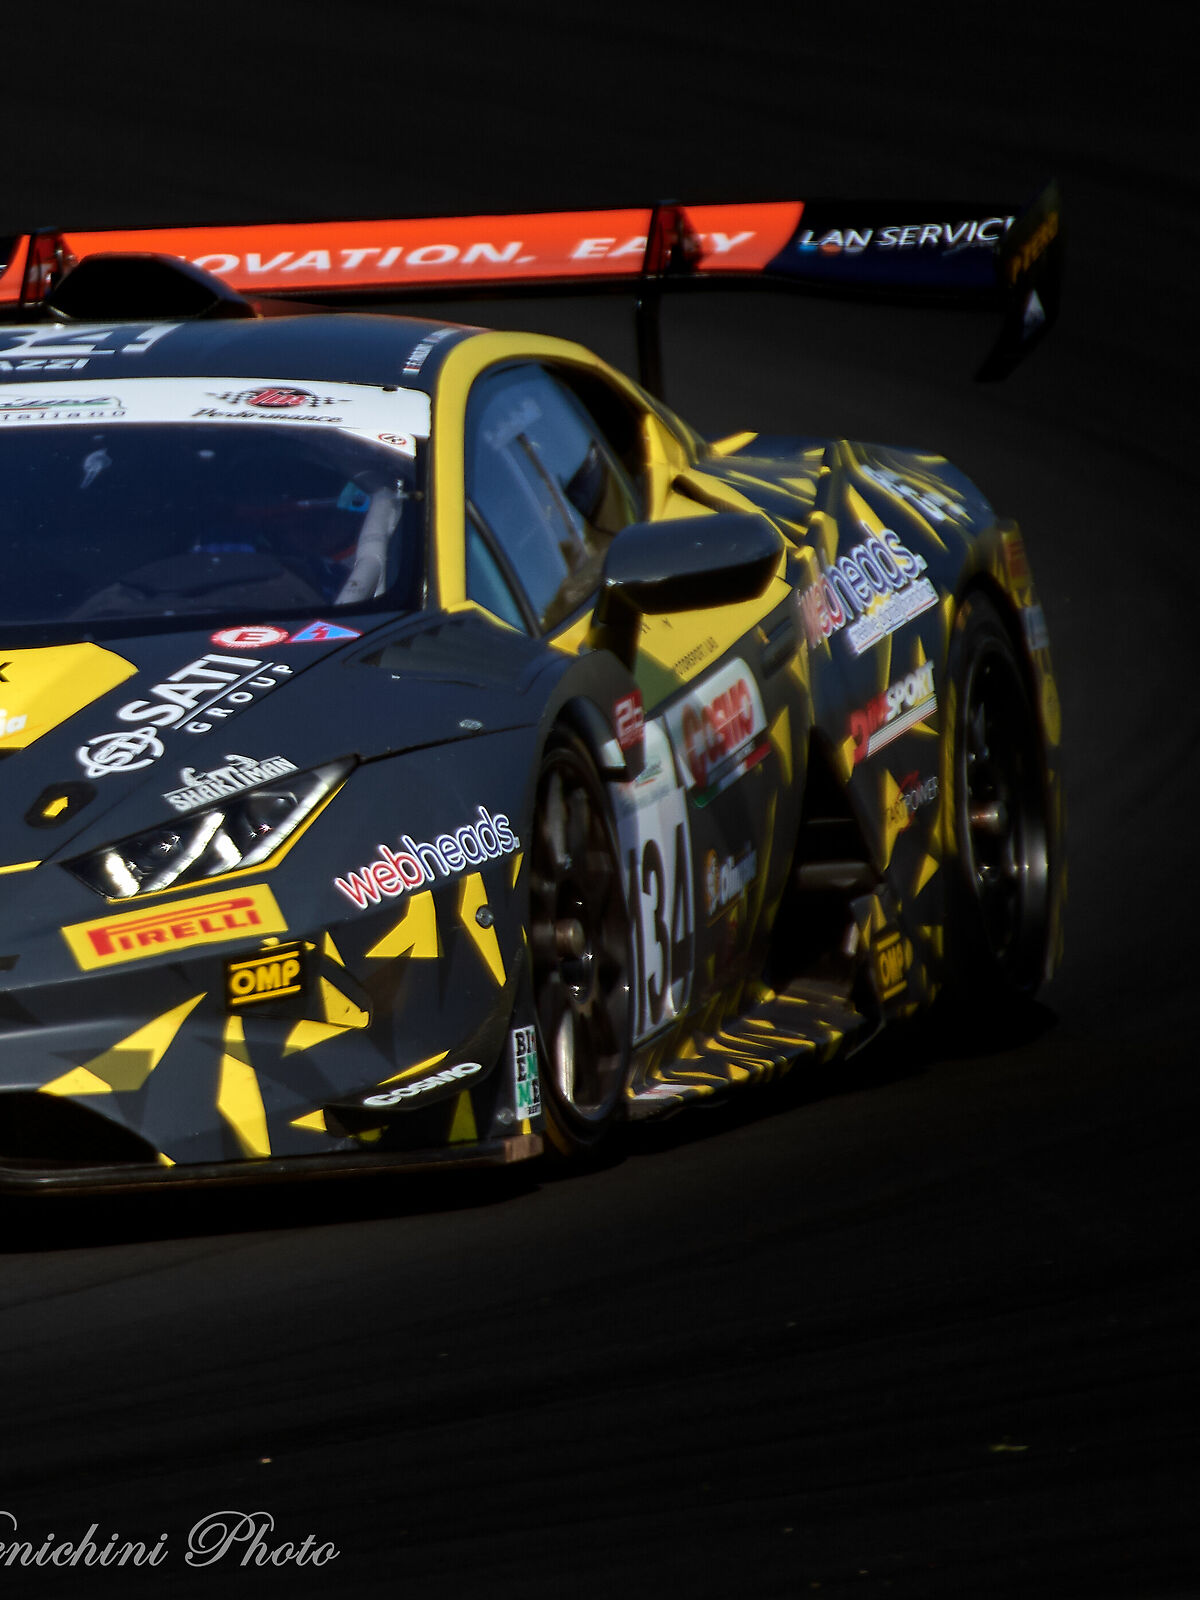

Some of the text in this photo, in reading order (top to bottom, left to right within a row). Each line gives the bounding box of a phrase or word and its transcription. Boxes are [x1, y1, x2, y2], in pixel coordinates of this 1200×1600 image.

[182, 230, 757, 276] OVATION. EAY
[800, 229, 874, 247] LAN
[116, 653, 264, 728] SATI
[189, 663, 295, 735] GROUP
[86, 896, 263, 956] PIRELLI
[629, 822, 695, 1037] 134
[230, 960, 300, 994] OMP
